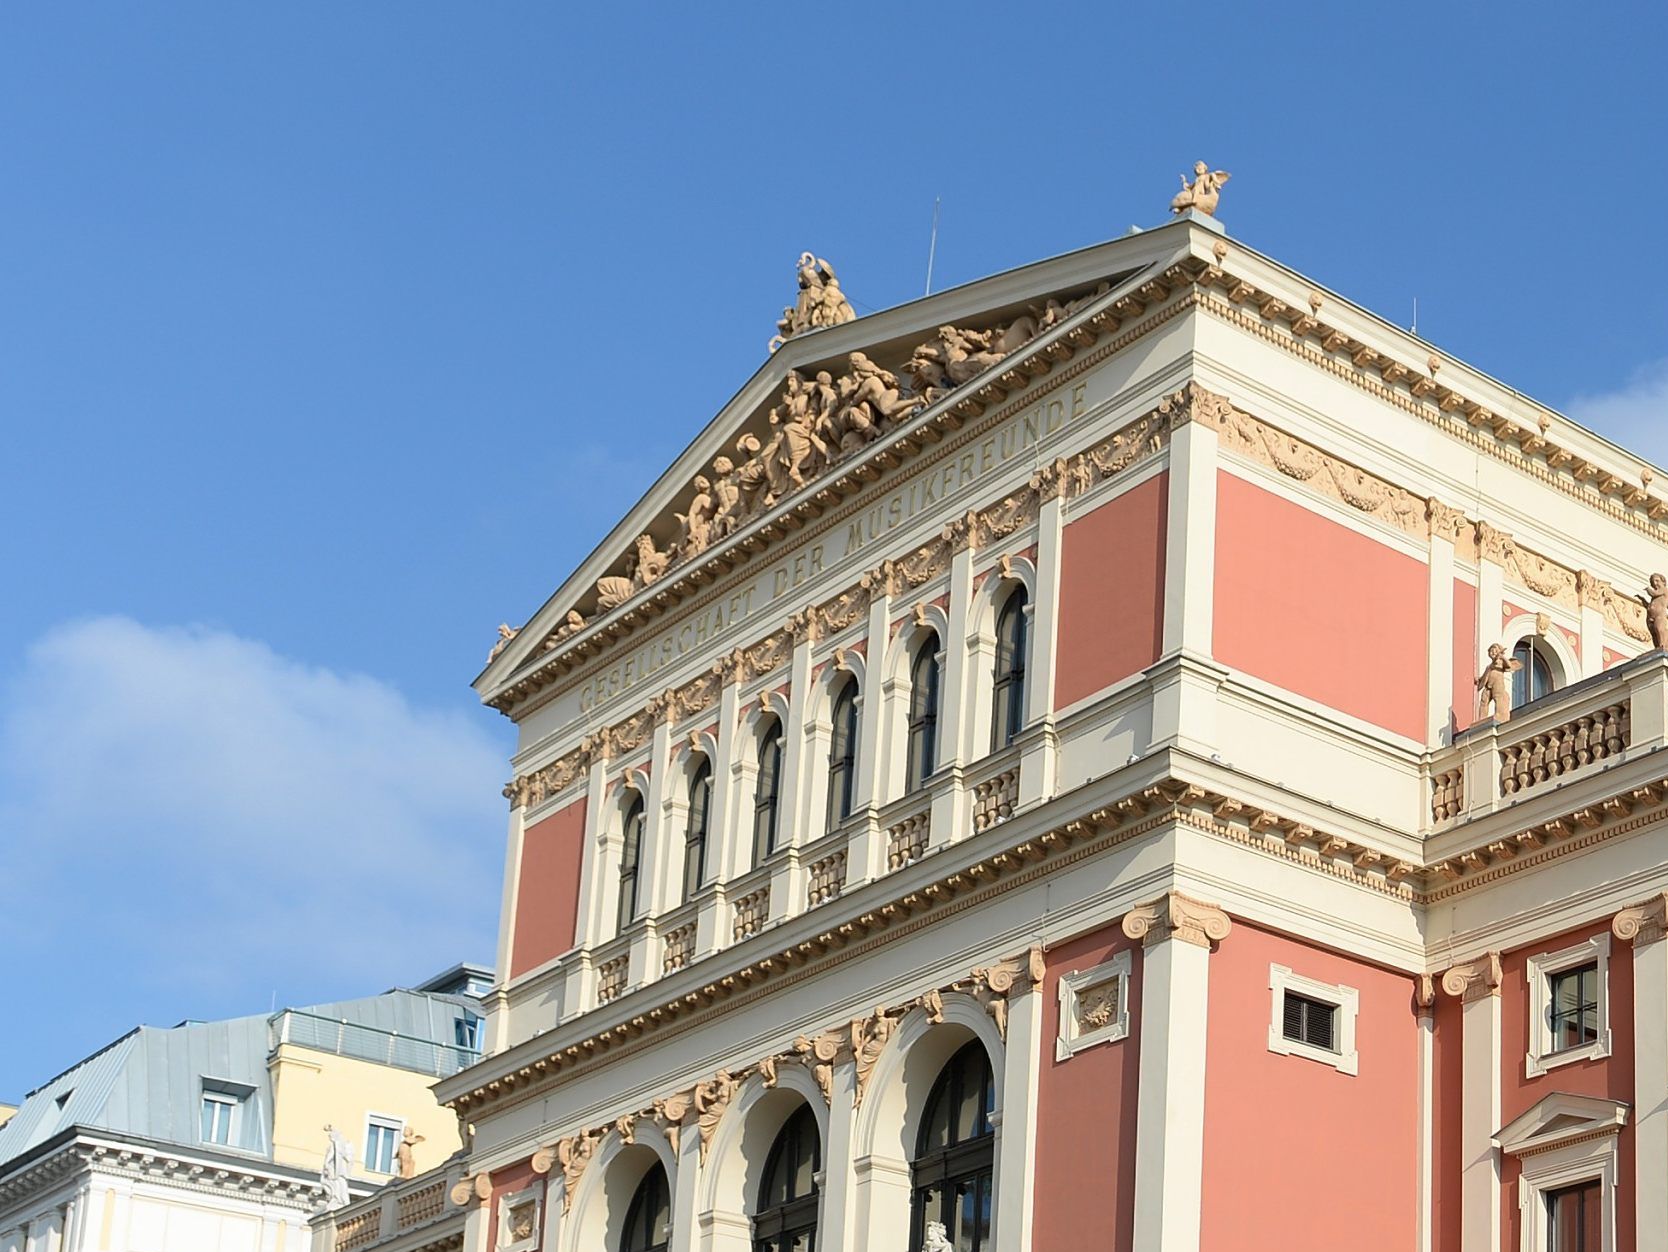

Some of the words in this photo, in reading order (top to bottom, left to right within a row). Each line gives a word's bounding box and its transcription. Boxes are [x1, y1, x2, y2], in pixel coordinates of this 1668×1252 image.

[579, 584, 757, 713] GESELLSCHAFT
[773, 544, 824, 598] DER
[844, 381, 1088, 556] MUSIKFREUNDE
